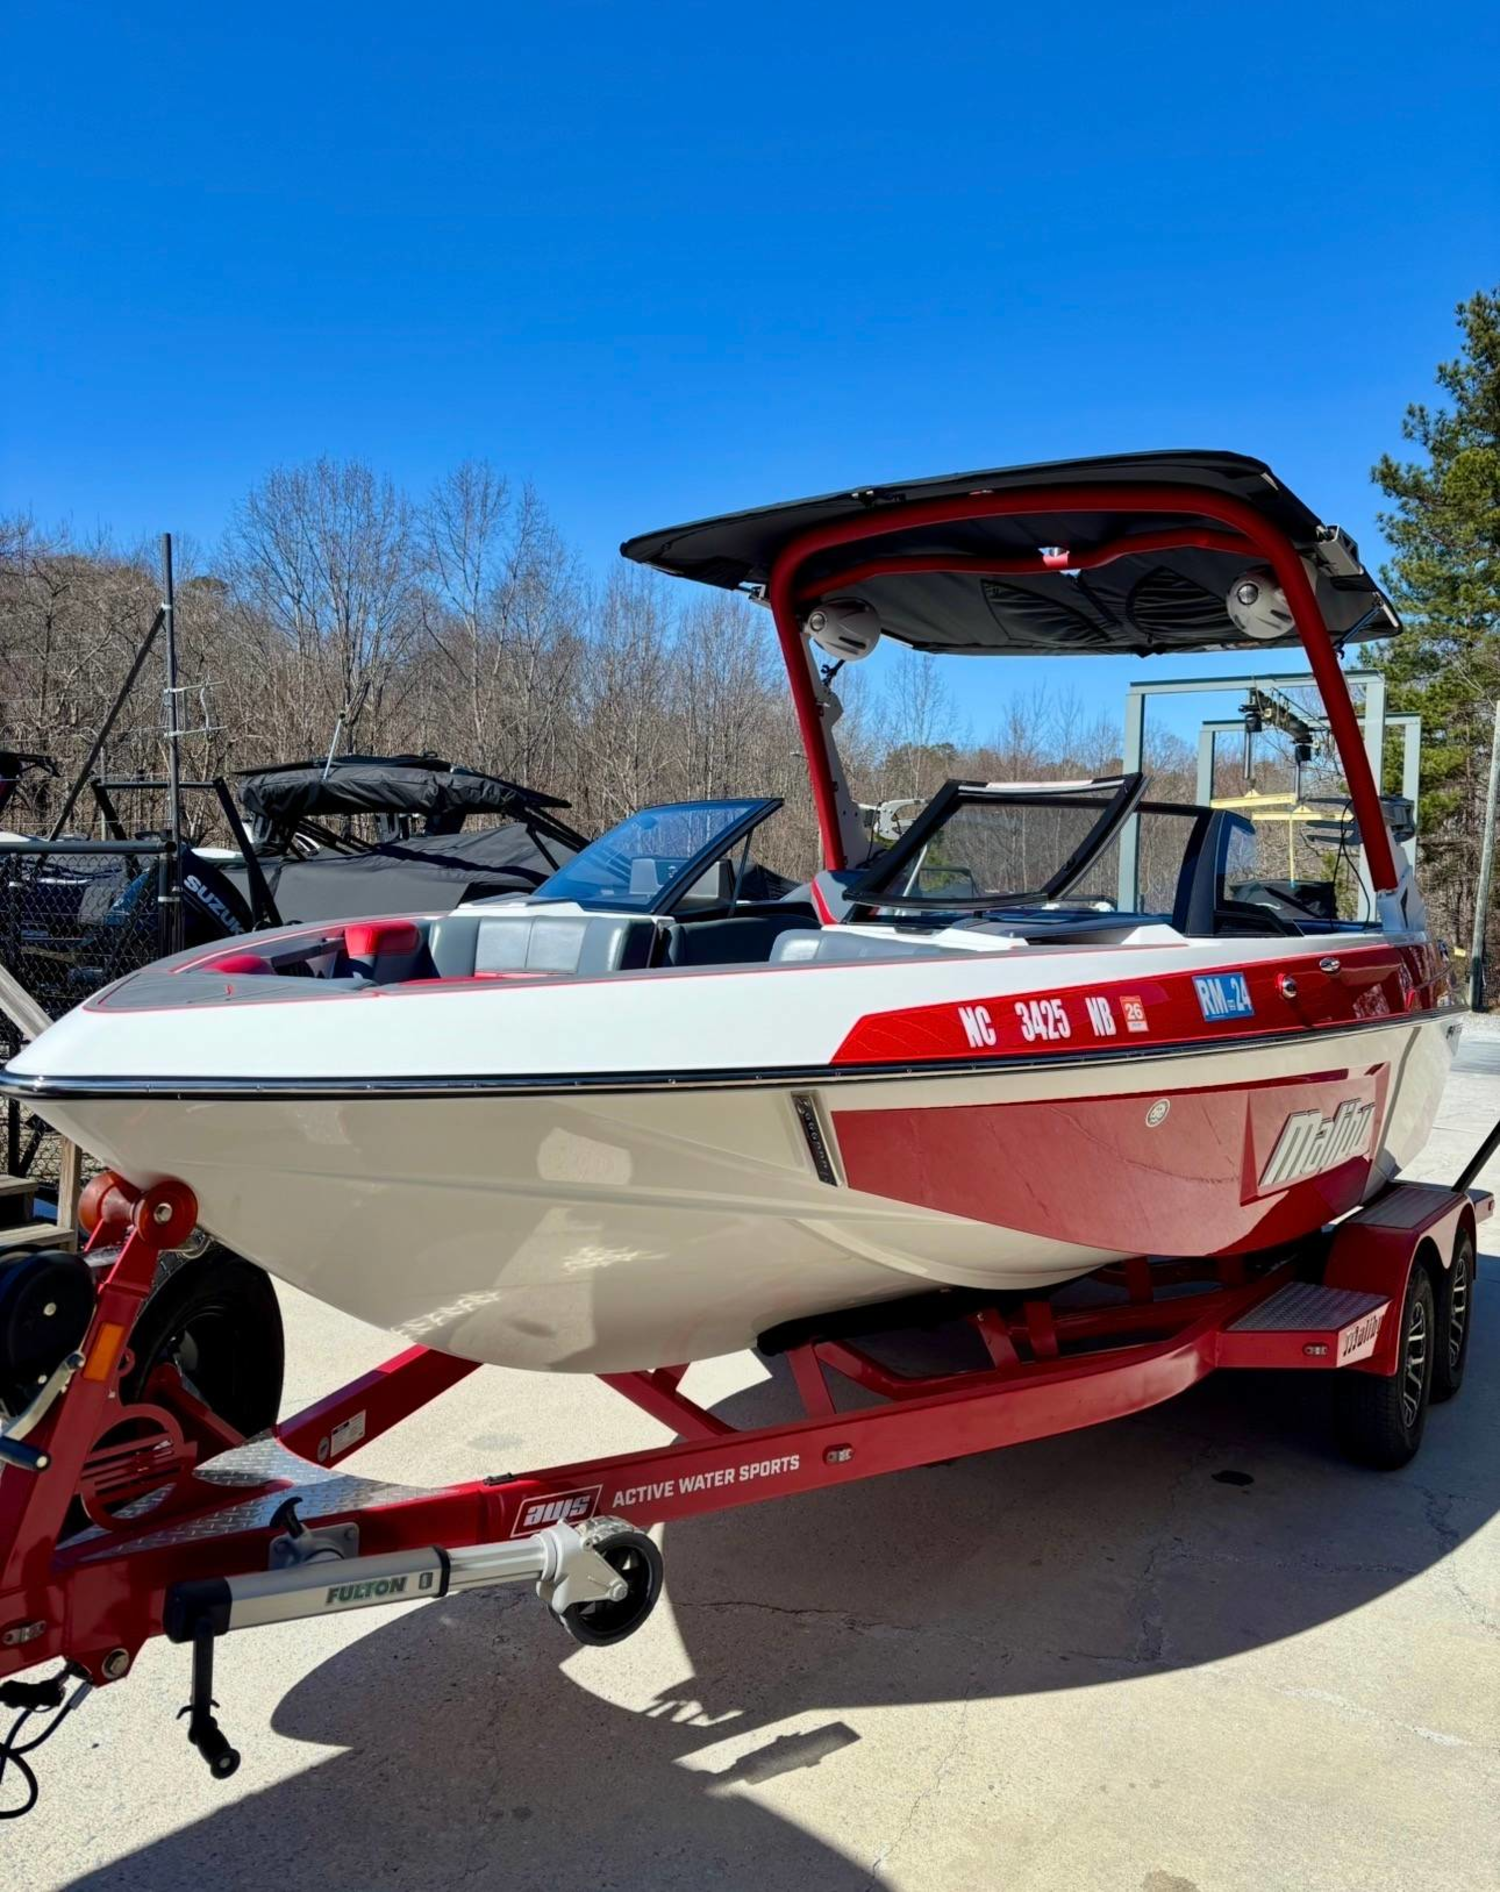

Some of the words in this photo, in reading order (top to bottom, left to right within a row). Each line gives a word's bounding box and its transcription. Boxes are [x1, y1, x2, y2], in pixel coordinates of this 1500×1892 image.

[184, 875, 246, 935] SUZUK
[958, 1005, 997, 1048] NC
[1014, 999, 1071, 1042] 3425
[1085, 997, 1117, 1037] NB
[1124, 1003, 1144, 1020] 26
[1257, 1098, 1376, 1187] Malibu
[612, 1481, 675, 1508] ACTIVE
[678, 1468, 736, 1494] WATER
[739, 1455, 800, 1482] SPORTS
[325, 1576, 408, 1604] FULTON
